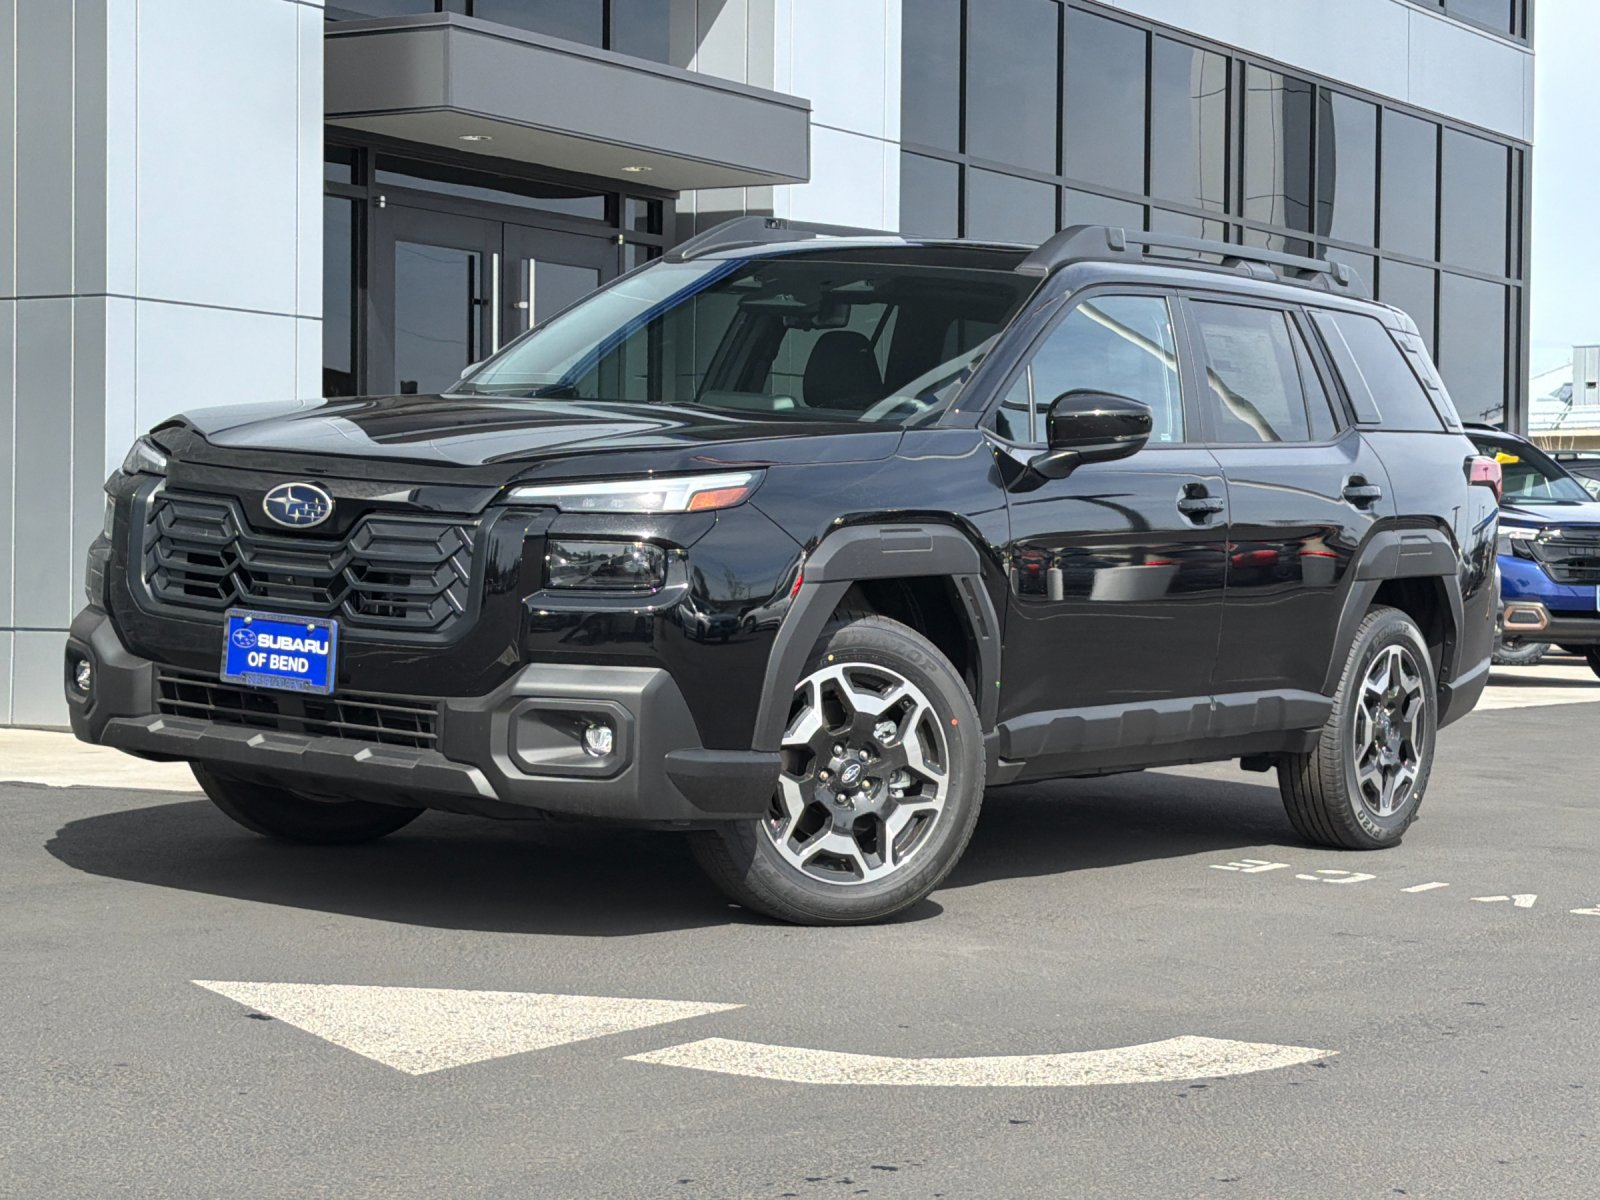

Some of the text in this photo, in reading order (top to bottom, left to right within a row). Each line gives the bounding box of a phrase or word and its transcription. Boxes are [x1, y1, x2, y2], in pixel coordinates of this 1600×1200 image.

[257, 634, 329, 655] SUBARU
[248, 651, 309, 673] OF BEND
[1357, 809, 1383, 838] PT20
